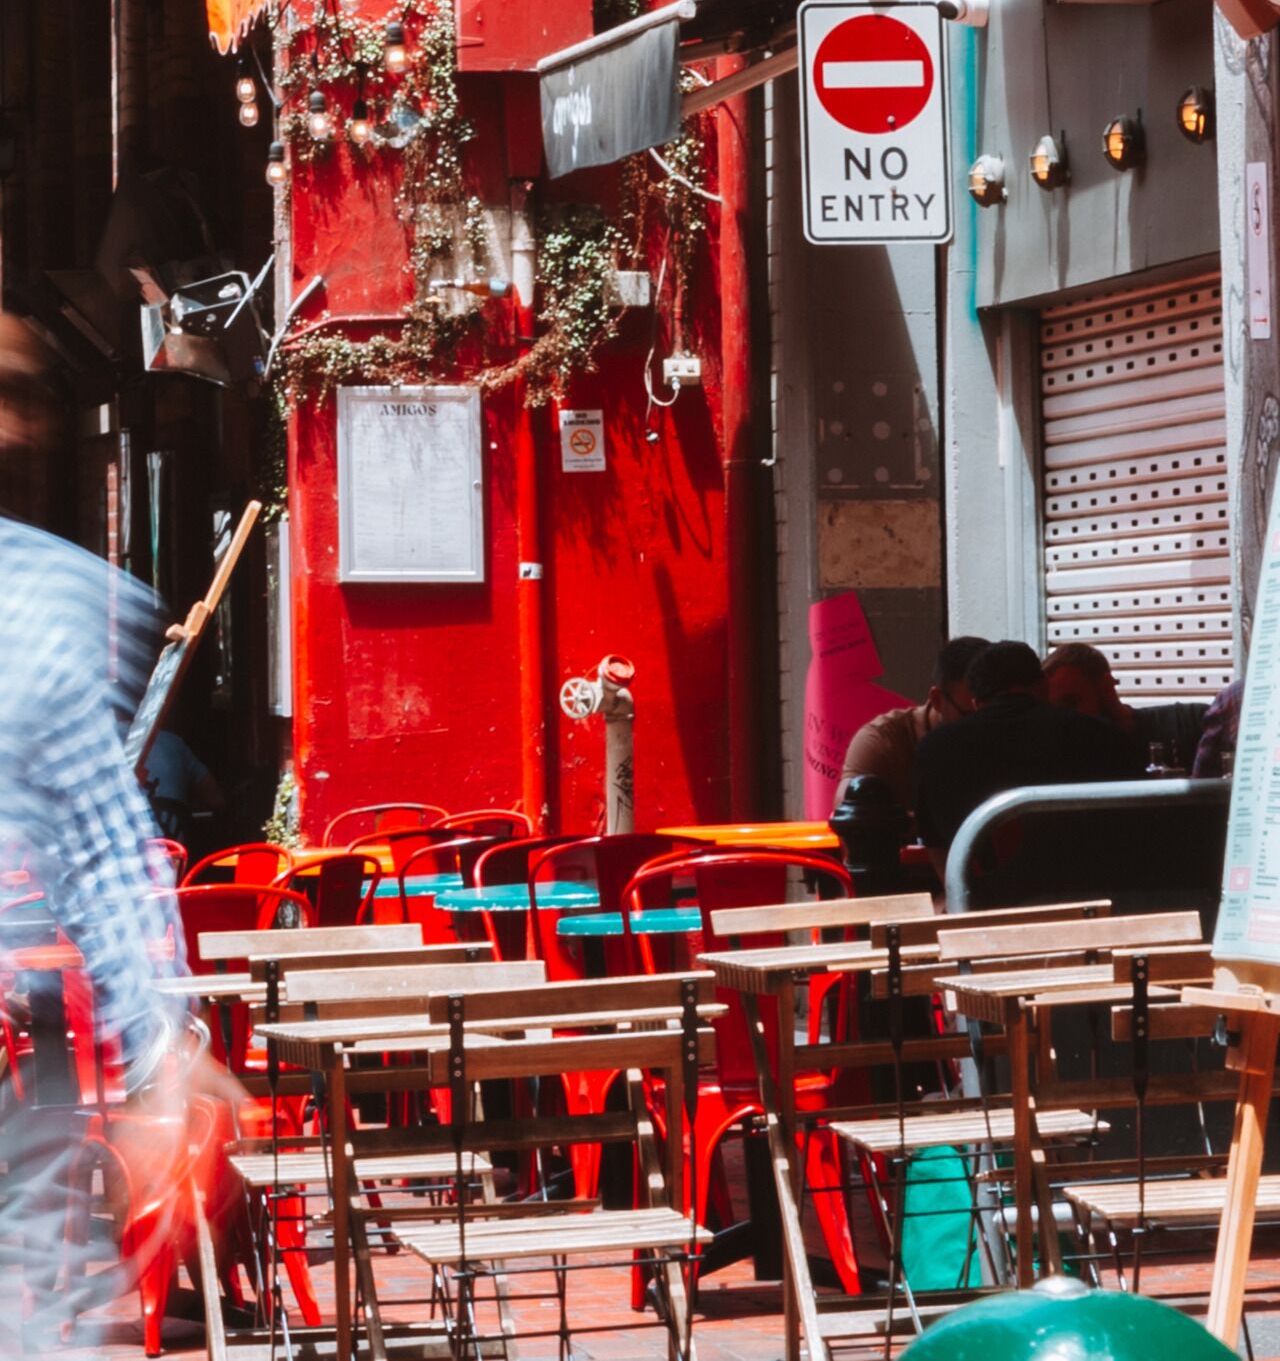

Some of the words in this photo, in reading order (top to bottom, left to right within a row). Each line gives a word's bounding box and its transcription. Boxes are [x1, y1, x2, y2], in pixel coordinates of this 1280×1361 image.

[843, 146, 909, 182] NO
[820, 192, 937, 223] ENTRY
[379, 403, 437, 417] AMIGOS
